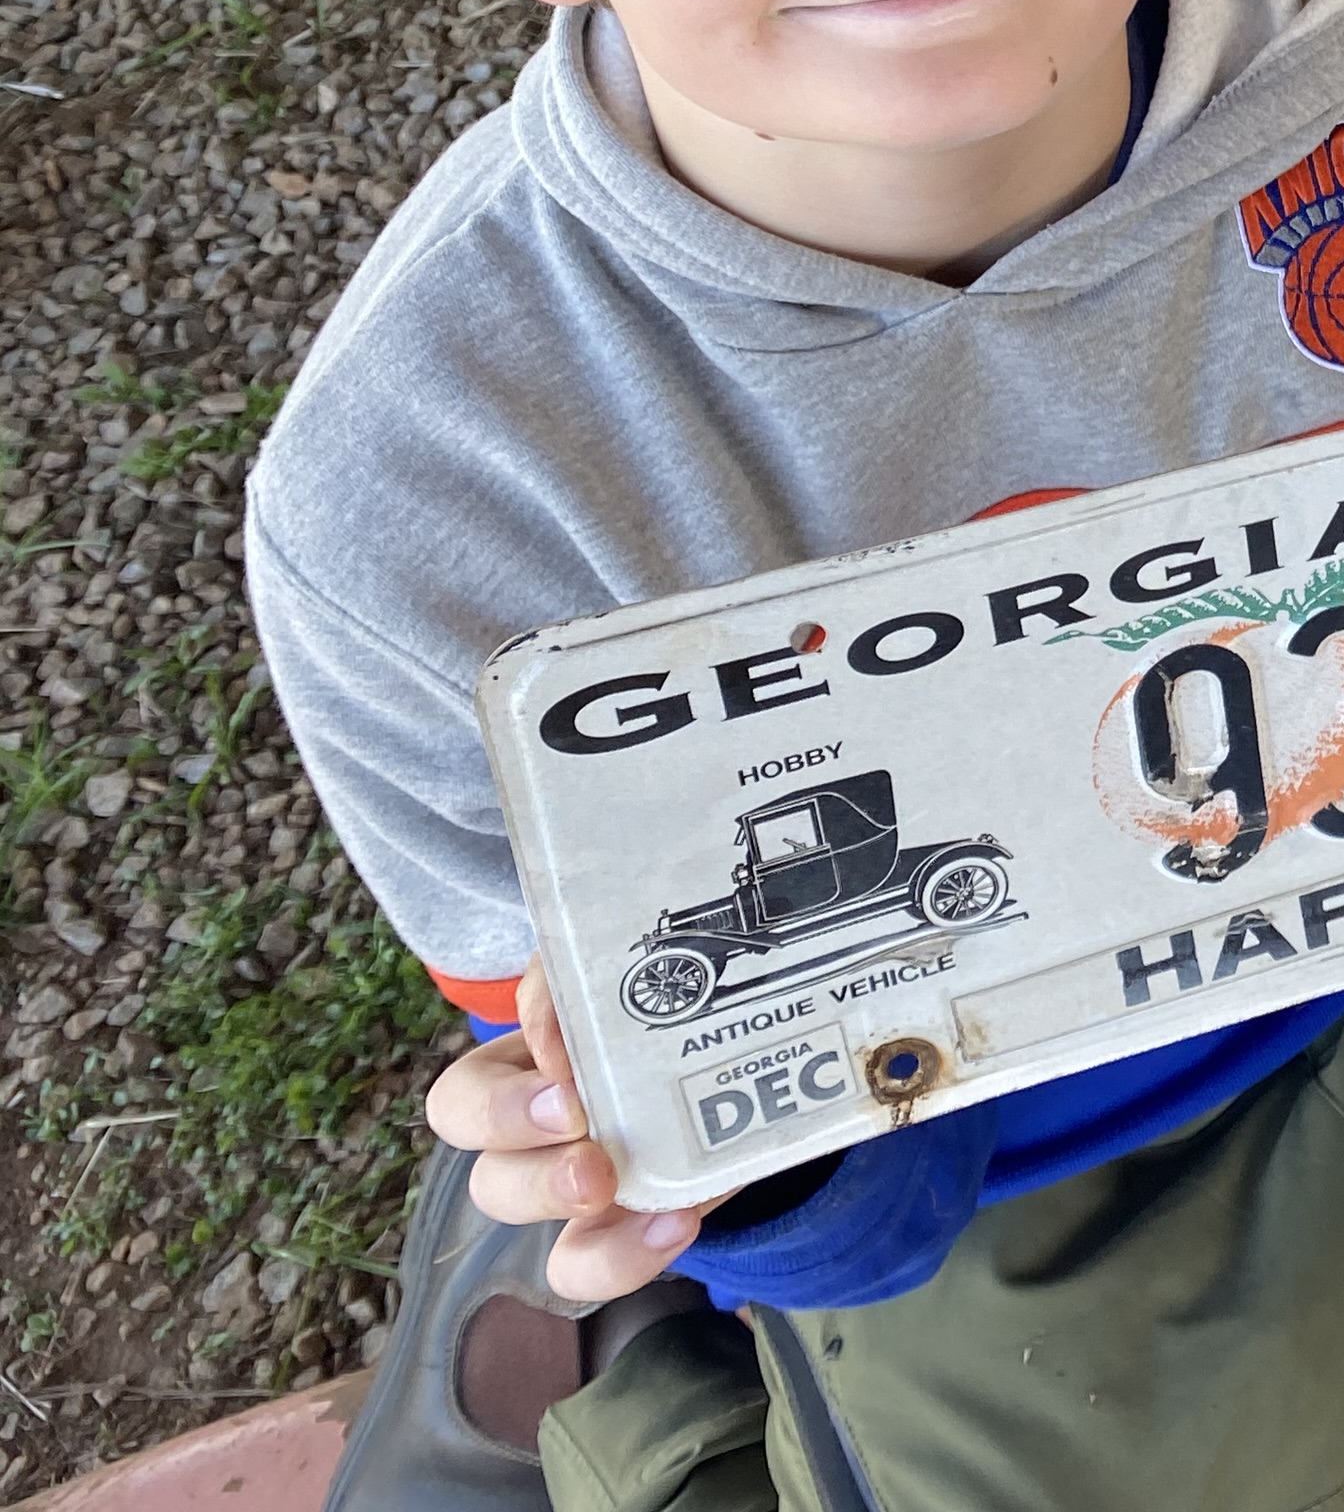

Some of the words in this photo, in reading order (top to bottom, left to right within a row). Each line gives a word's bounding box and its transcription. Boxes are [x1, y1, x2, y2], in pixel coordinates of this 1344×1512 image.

[737, 740, 843, 787] HOBBY
[680, 997, 817, 1058] ANTIQUE
[828, 951, 957, 1004] VEHICLE
[697, 1050, 846, 1147] DEC
[715, 1042, 813, 1087] GEORGIA
